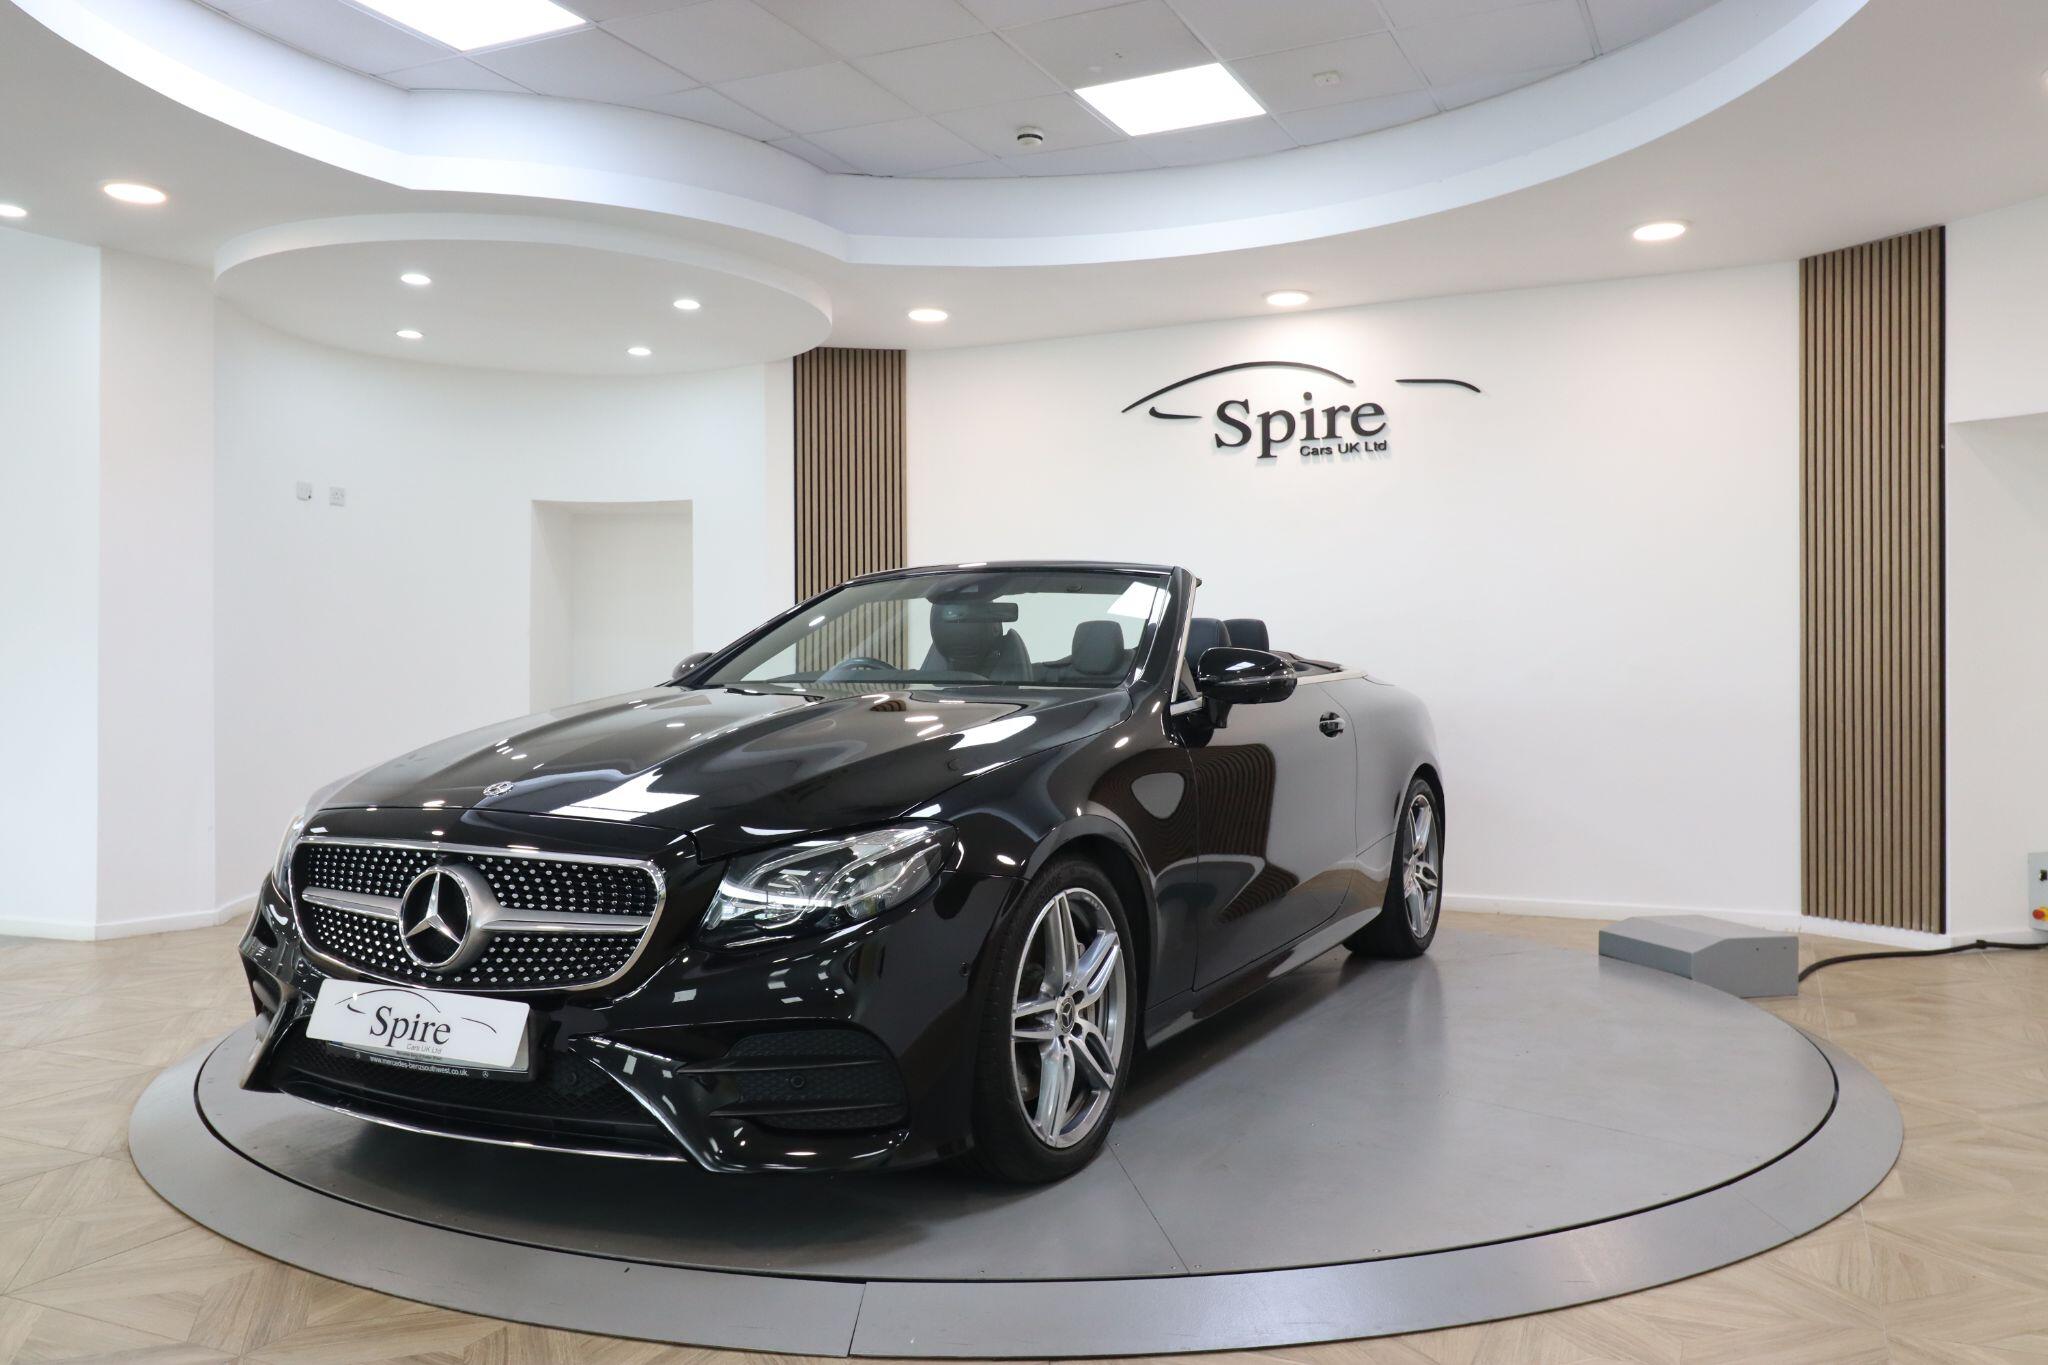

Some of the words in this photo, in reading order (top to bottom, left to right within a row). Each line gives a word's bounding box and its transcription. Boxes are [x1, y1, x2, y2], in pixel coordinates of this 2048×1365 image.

[1214, 391, 1386, 459] Spire
[1300, 445, 1333, 456] Cars
[1338, 442, 1360, 454] UK
[1364, 440, 1387, 452] Ltd
[369, 1005, 451, 1047] Spire
[406, 1043, 420, 1051] Cars
